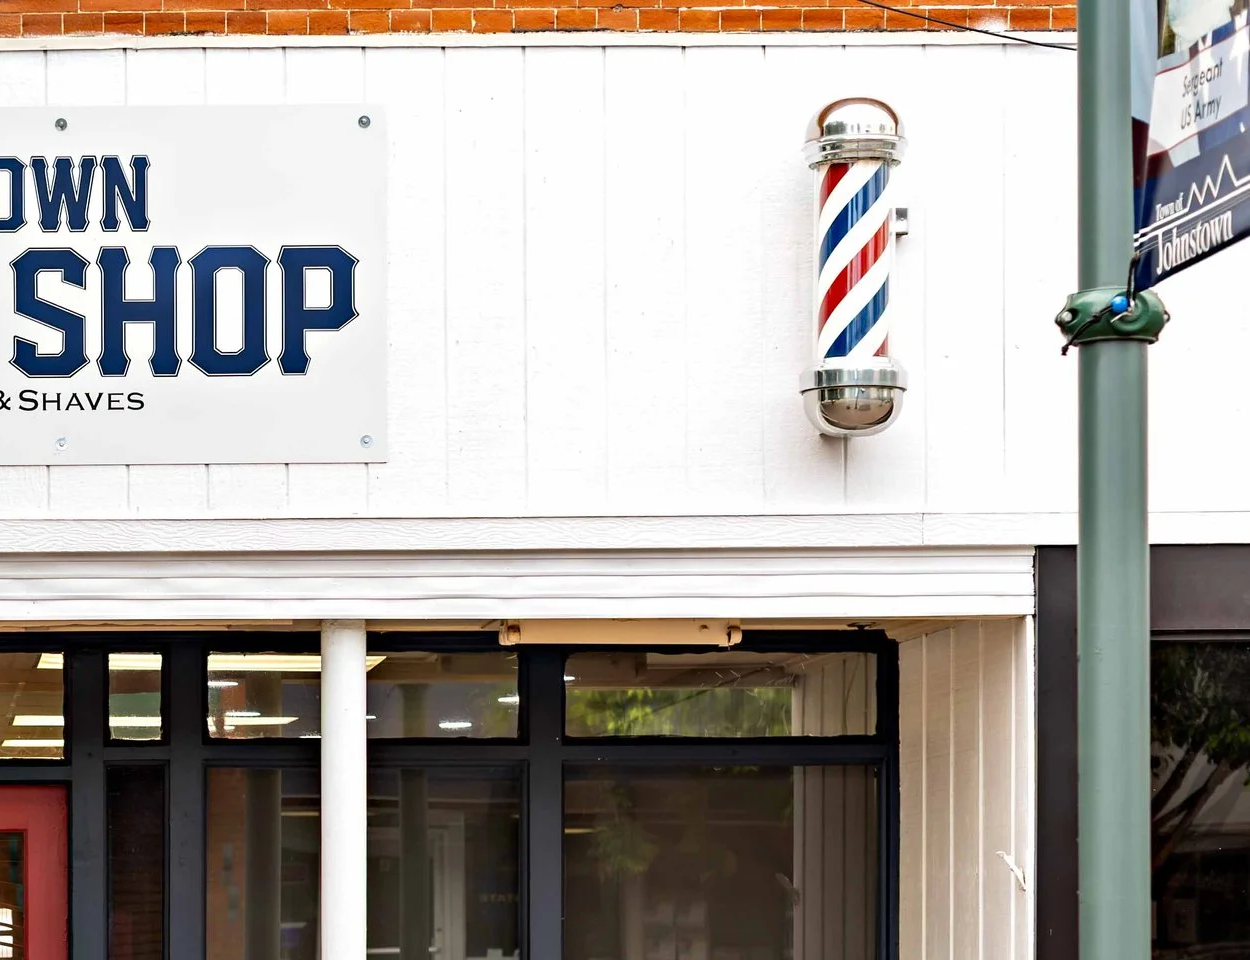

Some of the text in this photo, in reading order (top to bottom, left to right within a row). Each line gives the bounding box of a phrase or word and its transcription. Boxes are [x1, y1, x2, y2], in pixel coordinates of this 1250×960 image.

[1182, 57, 1223, 98] Sergeant
[1180, 95, 1222, 129] US Army
[1156, 192, 1184, 221] Town of
[1156, 210, 1234, 275] Johnstown
[7, 244, 360, 379] SHOP
[18, 389, 146, 412] SHAVES
